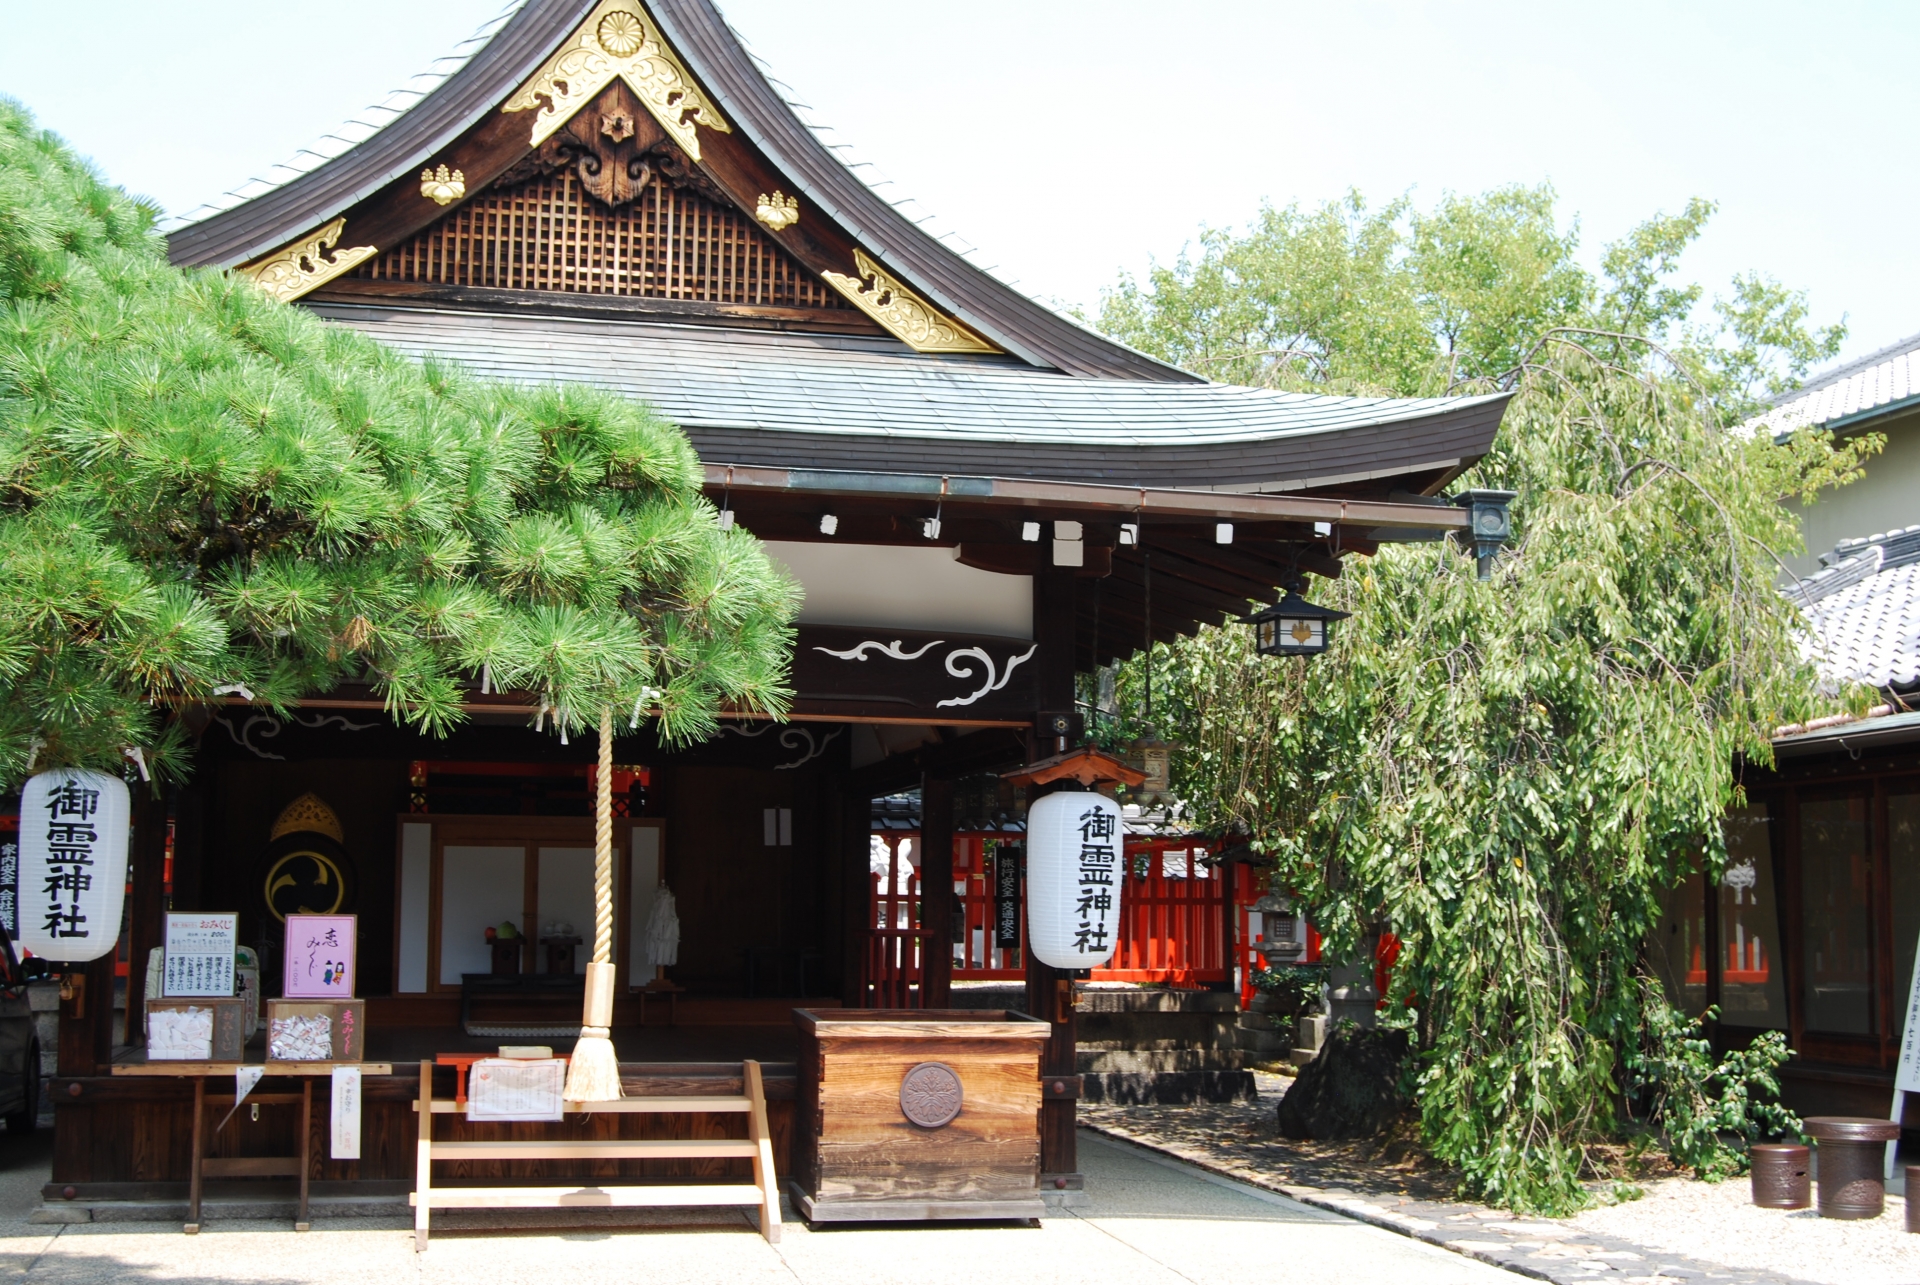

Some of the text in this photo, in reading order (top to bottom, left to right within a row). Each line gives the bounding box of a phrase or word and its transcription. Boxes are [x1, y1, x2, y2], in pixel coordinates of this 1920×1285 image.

[0, 843, 17, 885] 家内安全
[41, 780, 100, 939] 御霊神社
[1071, 805, 1116, 954] 御霊神社
[1001, 858, 1015, 940] 旅行安全 交通安全
[199, 919, 233, 930] おみくじ
[321, 927, 338, 947] 恋
[341, 1009, 354, 1055] 恋みくじ
